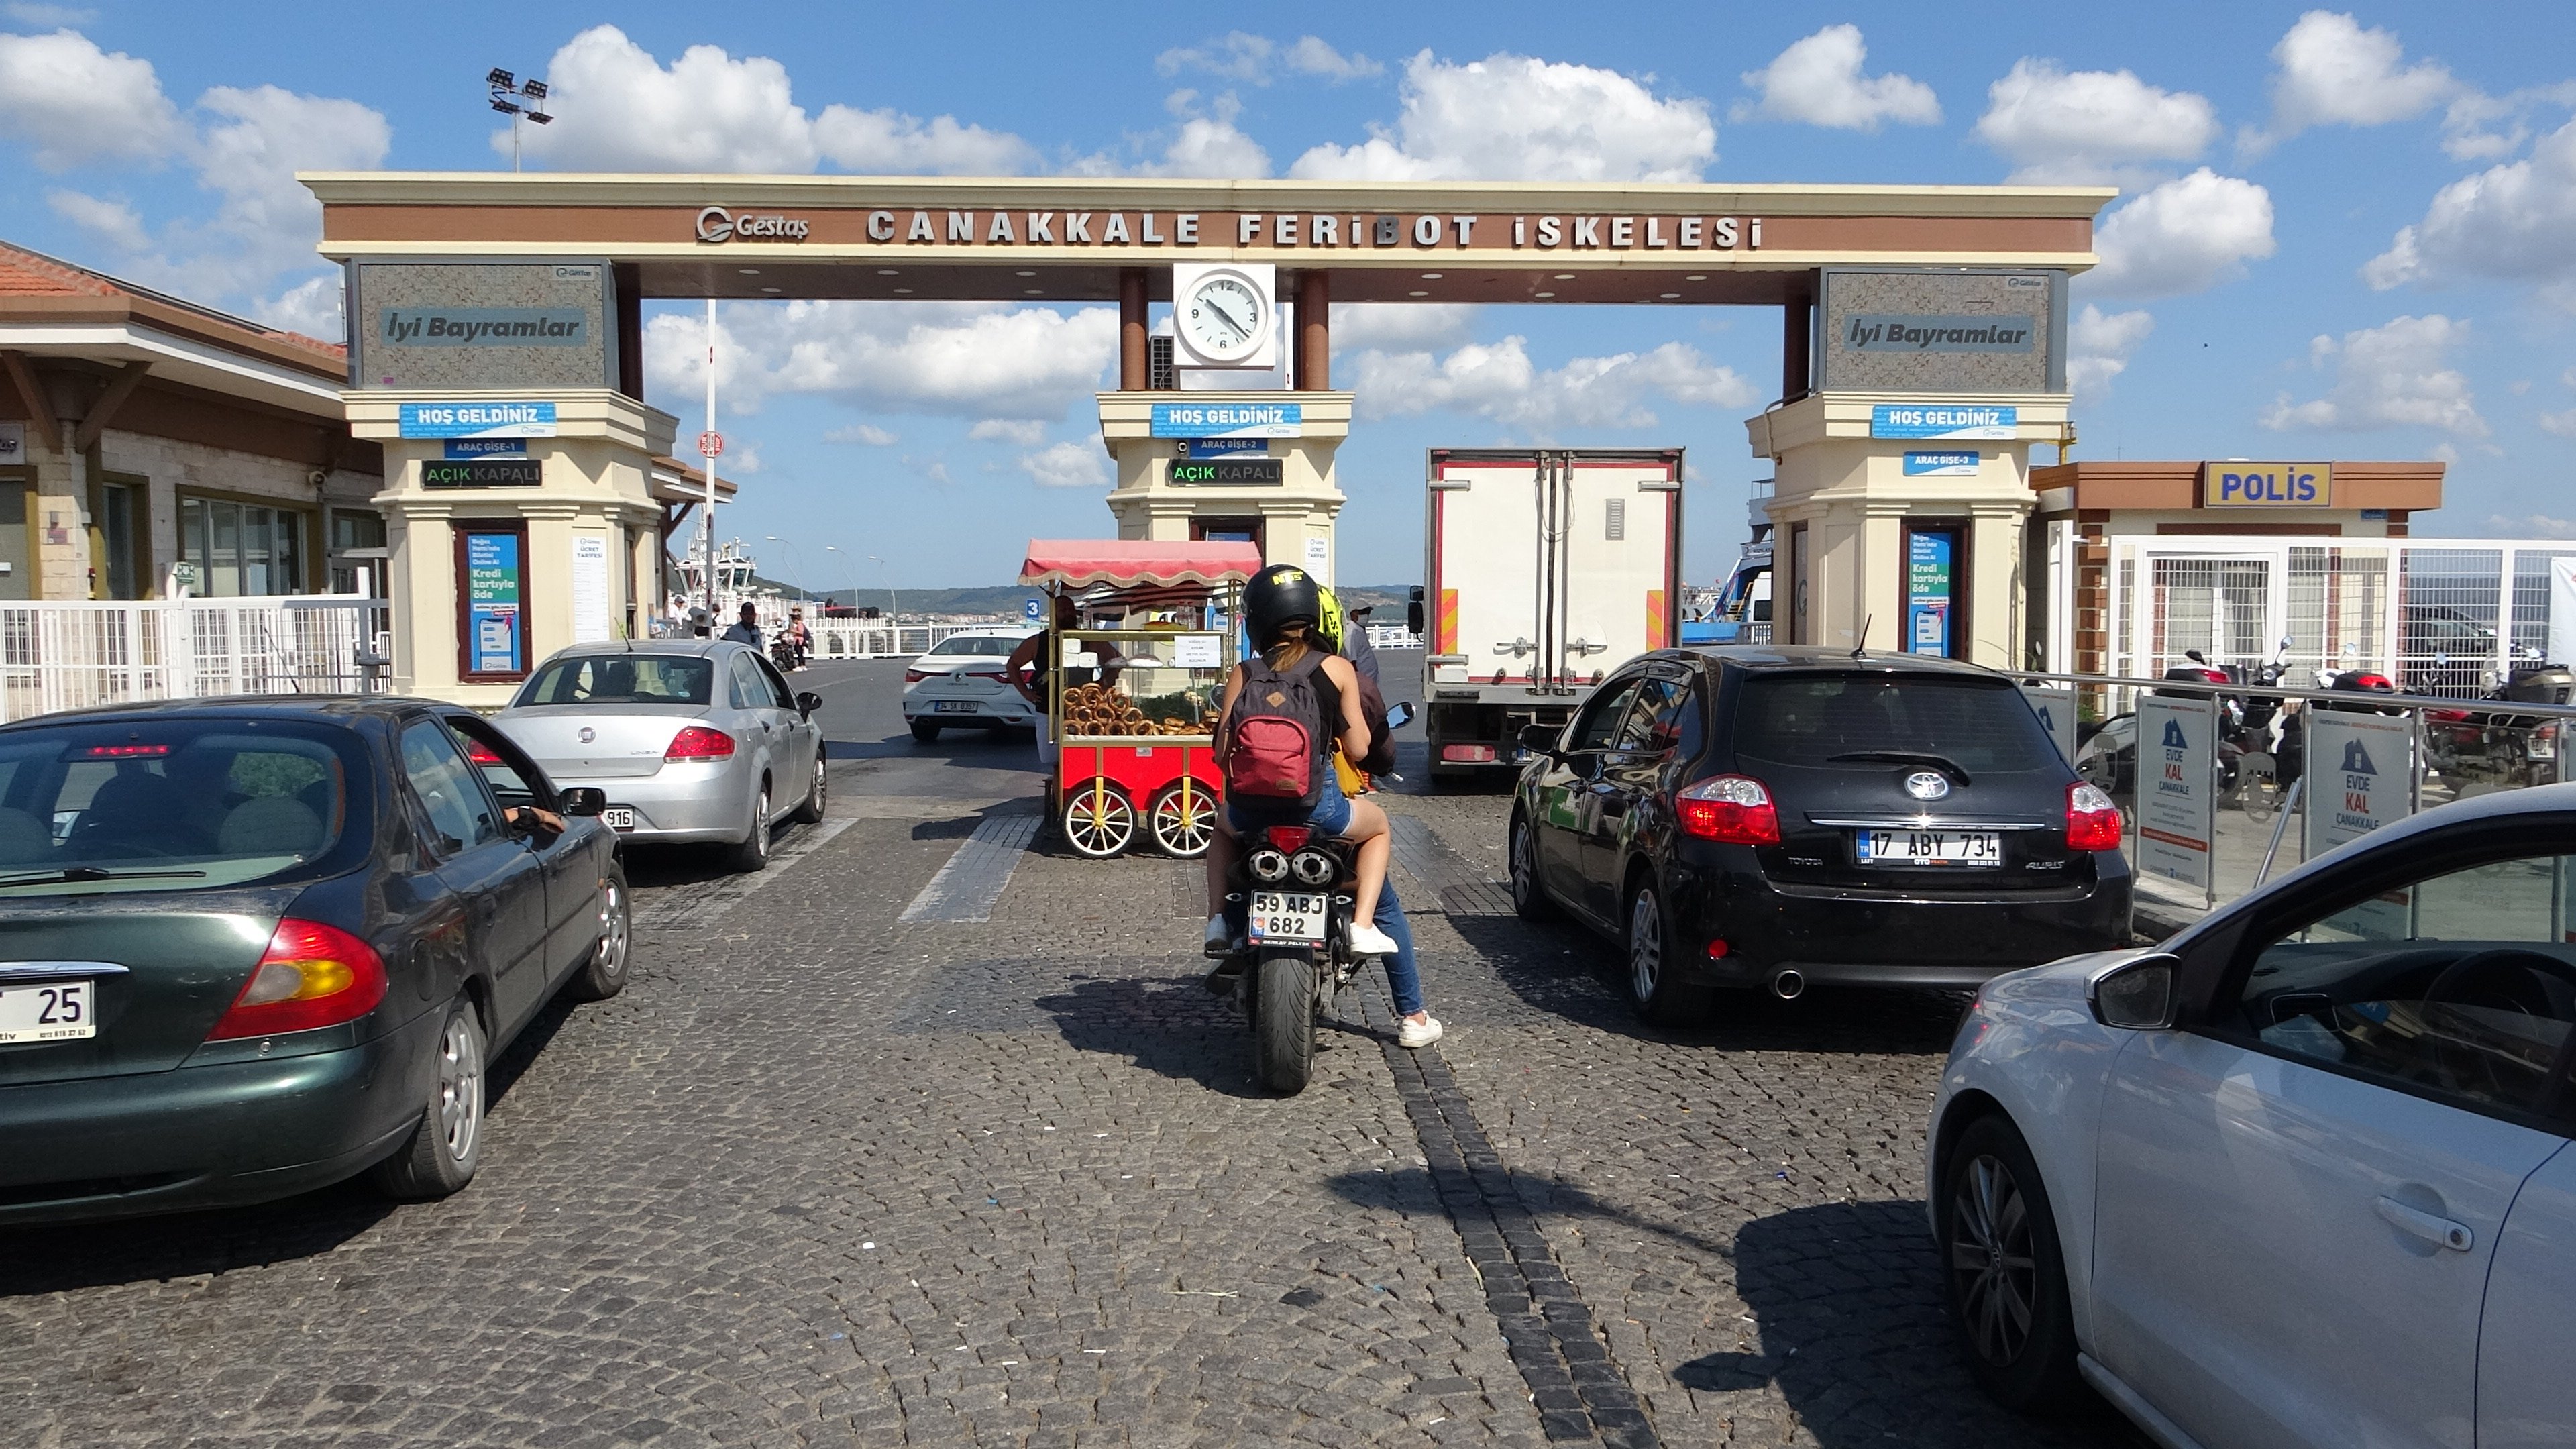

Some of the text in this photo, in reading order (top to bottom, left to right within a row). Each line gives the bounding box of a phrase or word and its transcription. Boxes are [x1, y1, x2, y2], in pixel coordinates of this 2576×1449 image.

[736, 213, 809, 239] Gestaş
[867, 211, 1199, 243] ÇANAKKALE
[1218, 280, 1234, 291] 12
[1191, 309, 1199, 319] 9
[1249, 312, 1257, 322] 3
[387, 312, 580, 343] İyi Bayramlar
[1849, 319, 2027, 349] İyi Bayramlar
[1219, 339, 1227, 349] 6
[418, 405, 538, 425] HOŞ GELDİNİZ
[1170, 405, 1284, 425] HOŞ GELDİNİZ
[1890, 408, 2000, 426] HOŞ GELDİNİZ
[456, 441, 516, 452] ARAÇ GİŞE-1
[1201, 439, 1257, 449] ARAÇ GİŞE-2
[1915, 454, 1969, 465] ARAÇ GİŞE-3
[427, 468, 539, 483] AÇIK KAPALI
[1218, 466, 1280, 480] KAPALI
[2221, 466, 2316, 502] POLİS
[472, 568, 502, 578] Kredi
[1912, 564, 1937, 572] Kredi
[472, 579, 515, 590] kartıyla
[1912, 574, 1948, 584] kartıyla
[473, 590, 493, 599] öde
[1912, 584, 1929, 593] öde
[1028, 602, 1038, 616] 3
[2165, 748, 2184, 763] EVDE
[2165, 763, 2183, 781] KAL
[2346, 774, 2371, 792] EVDE
[2345, 792, 2370, 814] KAL
[608, 811, 630, 826] 916
[2335, 812, 2380, 830] ÇANAKKALE
[1871, 833, 1997, 857] 17 ABY 734
[1788, 857, 1823, 866] TOYOTA
[1256, 894, 1324, 915] 59 ABJ
[1269, 916, 1305, 935] 682
[38, 987, 81, 1024] 25
